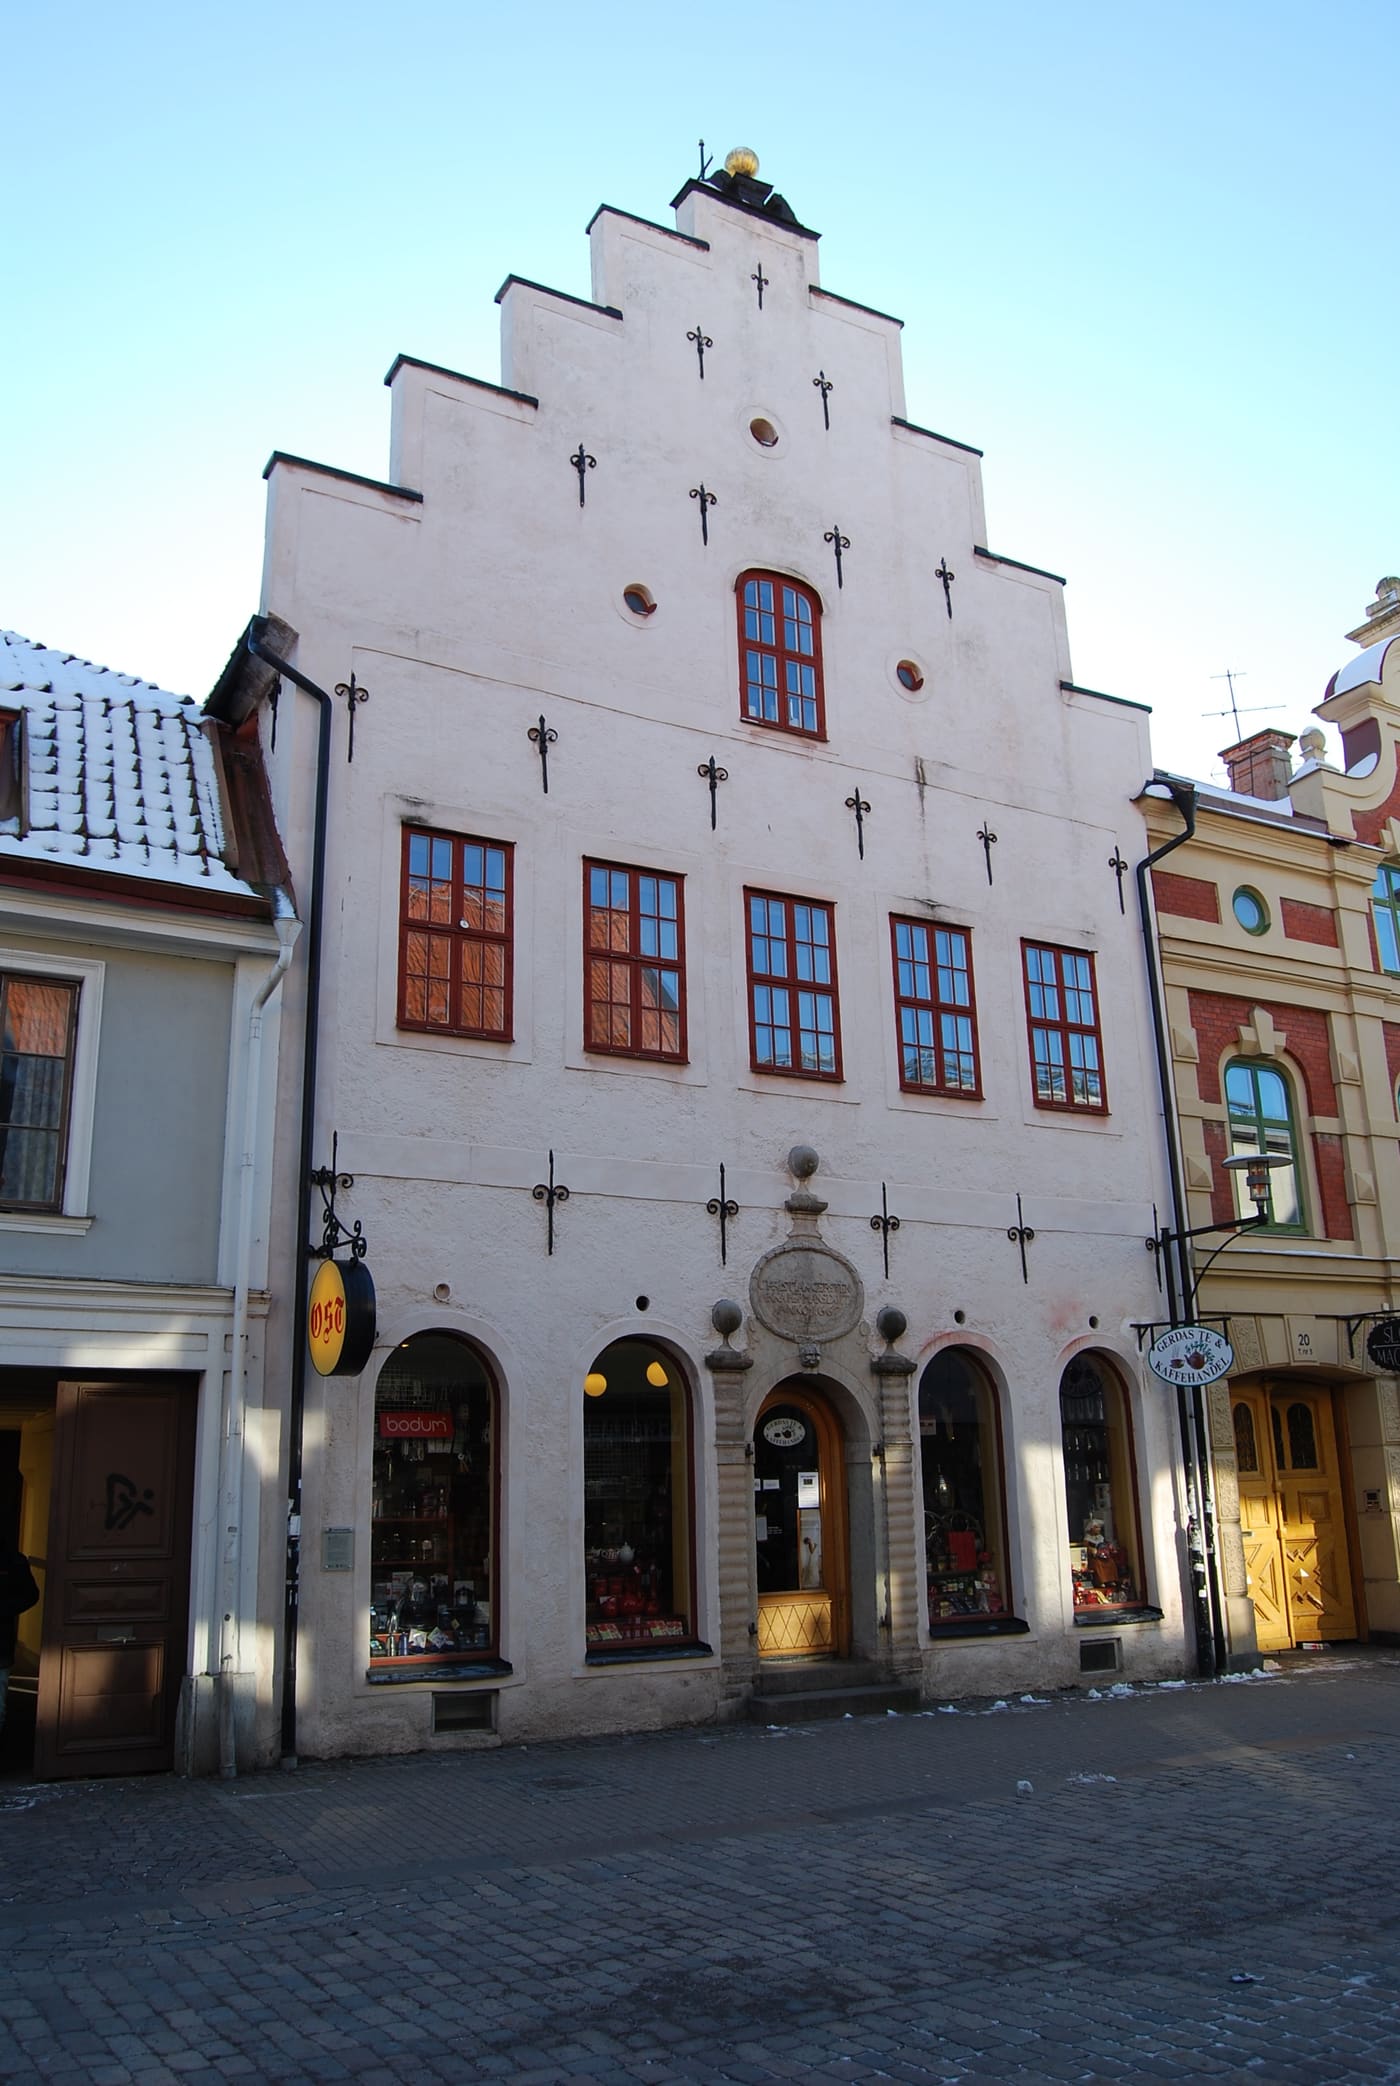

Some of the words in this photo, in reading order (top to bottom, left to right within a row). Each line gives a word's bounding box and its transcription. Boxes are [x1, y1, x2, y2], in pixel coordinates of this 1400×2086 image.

[311, 1296, 344, 1344] OST
[1157, 1329, 1194, 1352] GERDAS
[1199, 1330, 1213, 1343] TE
[1215, 1338, 1223, 1349] &
[1298, 1334, 1310, 1346] 20
[1155, 1357, 1229, 1383] KAFFEHANDEL
[387, 1416, 446, 1432] bodum
